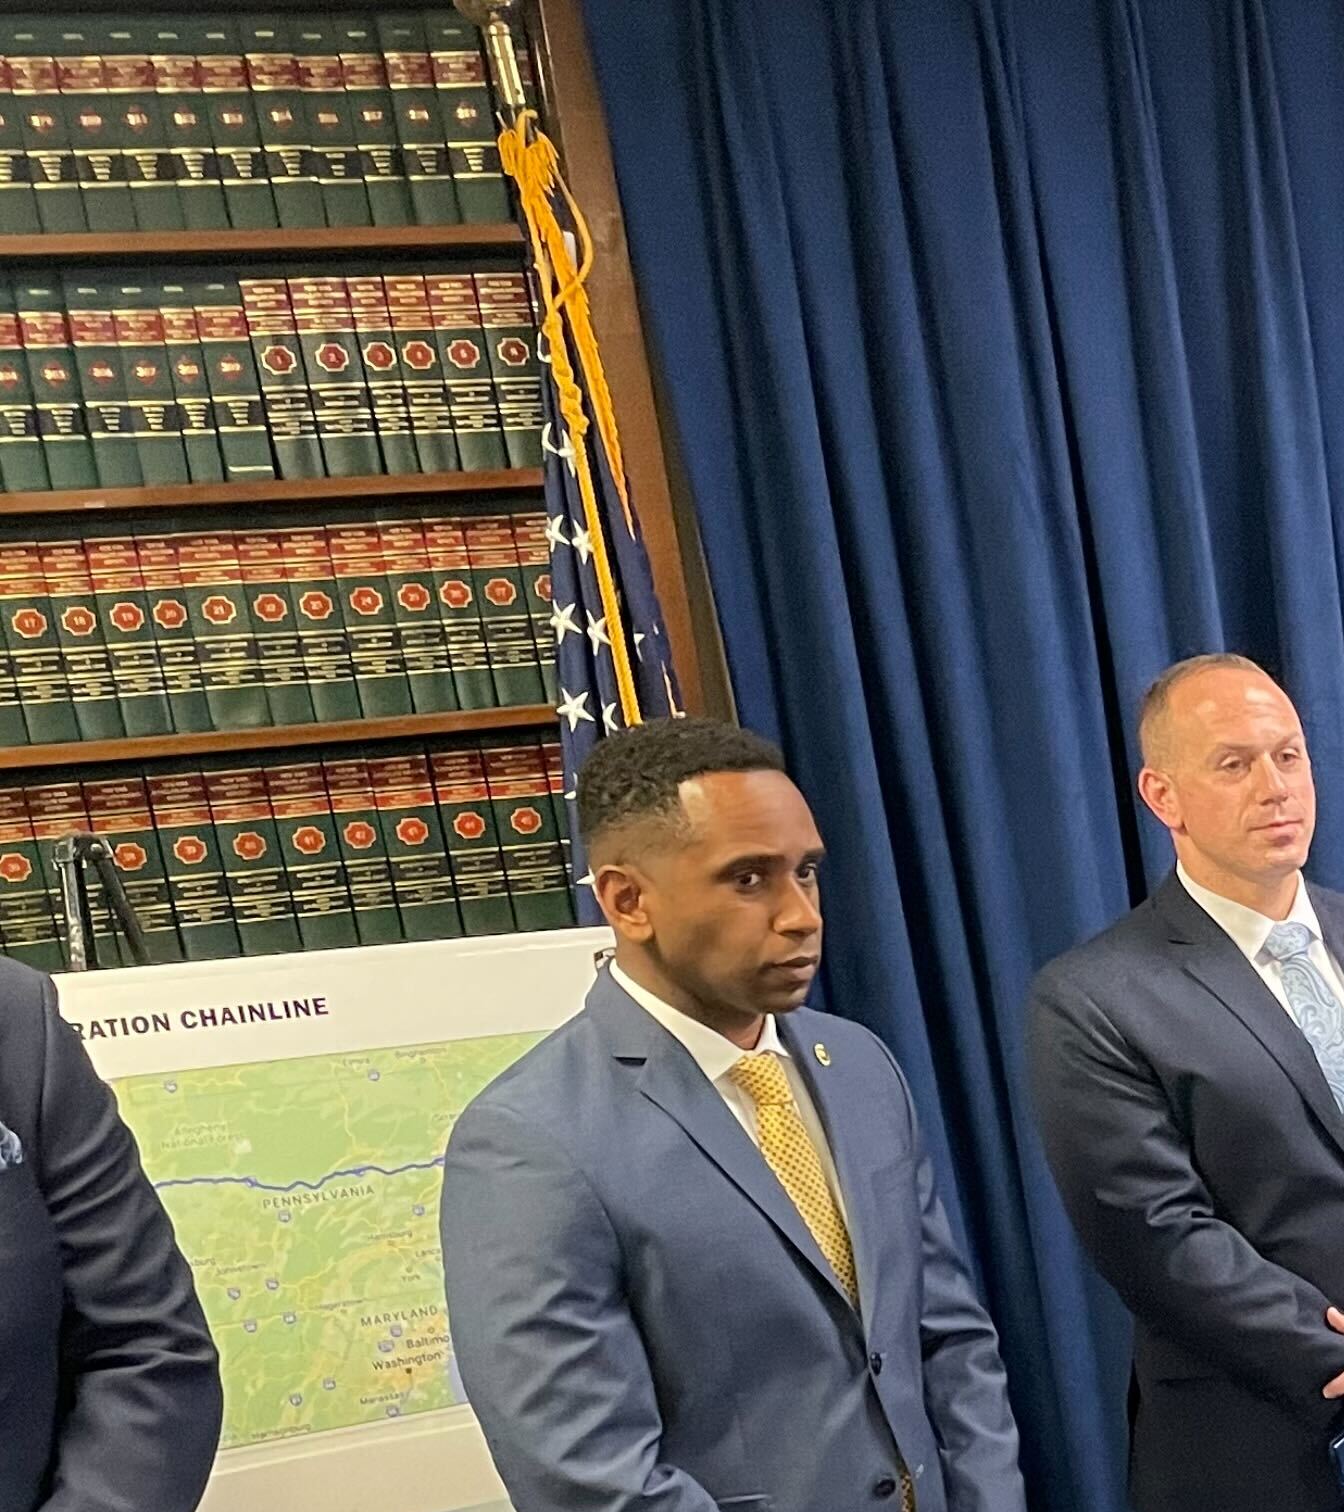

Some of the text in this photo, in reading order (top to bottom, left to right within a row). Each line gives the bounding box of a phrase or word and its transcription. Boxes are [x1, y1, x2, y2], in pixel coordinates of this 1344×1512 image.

[72, 997, 329, 1040] RATION CHAINLINE
[262, 1184, 375, 1209] PENNSYLVANIA
[360, 1304, 438, 1327] MARYLAND
[405, 1334, 450, 1349] Baltimo
[372, 1351, 441, 1371] Washington
